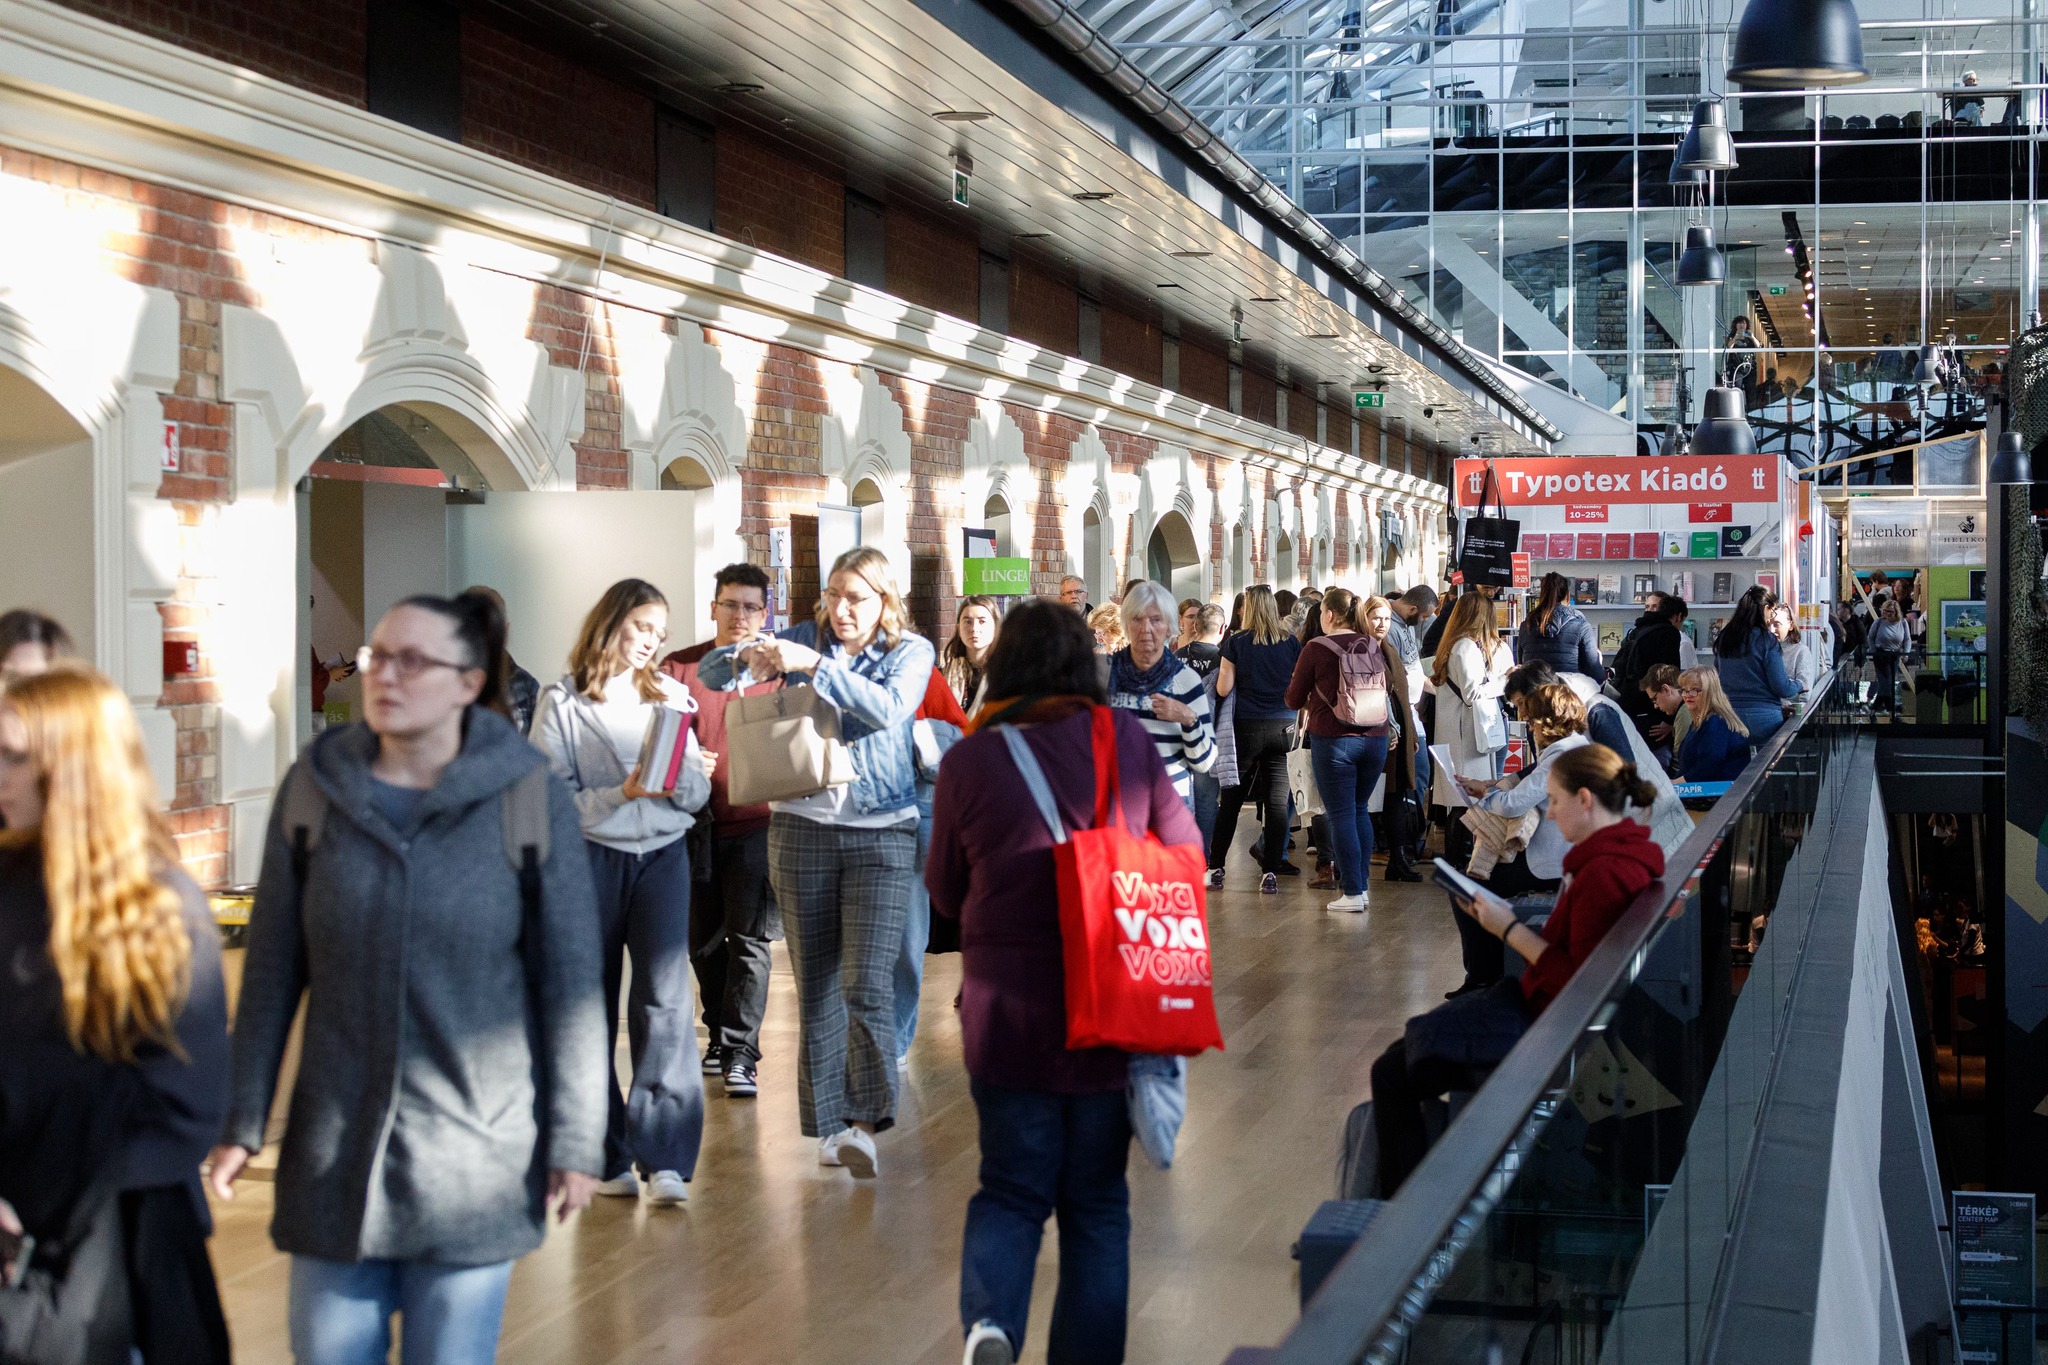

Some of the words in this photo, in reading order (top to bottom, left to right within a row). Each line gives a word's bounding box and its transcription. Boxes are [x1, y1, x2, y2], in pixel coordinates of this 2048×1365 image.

[1506, 471, 1631, 497] Typotex
[1640, 465, 1728, 492] Kiadó
[1569, 511, 1605, 519] 10-25%
[1860, 524, 1918, 541] jelenkor
[981, 569, 1028, 583] LINGEA
[1679, 784, 1703, 794] PAPÍR
[1958, 1205, 1999, 1216] TÉRKÉP
